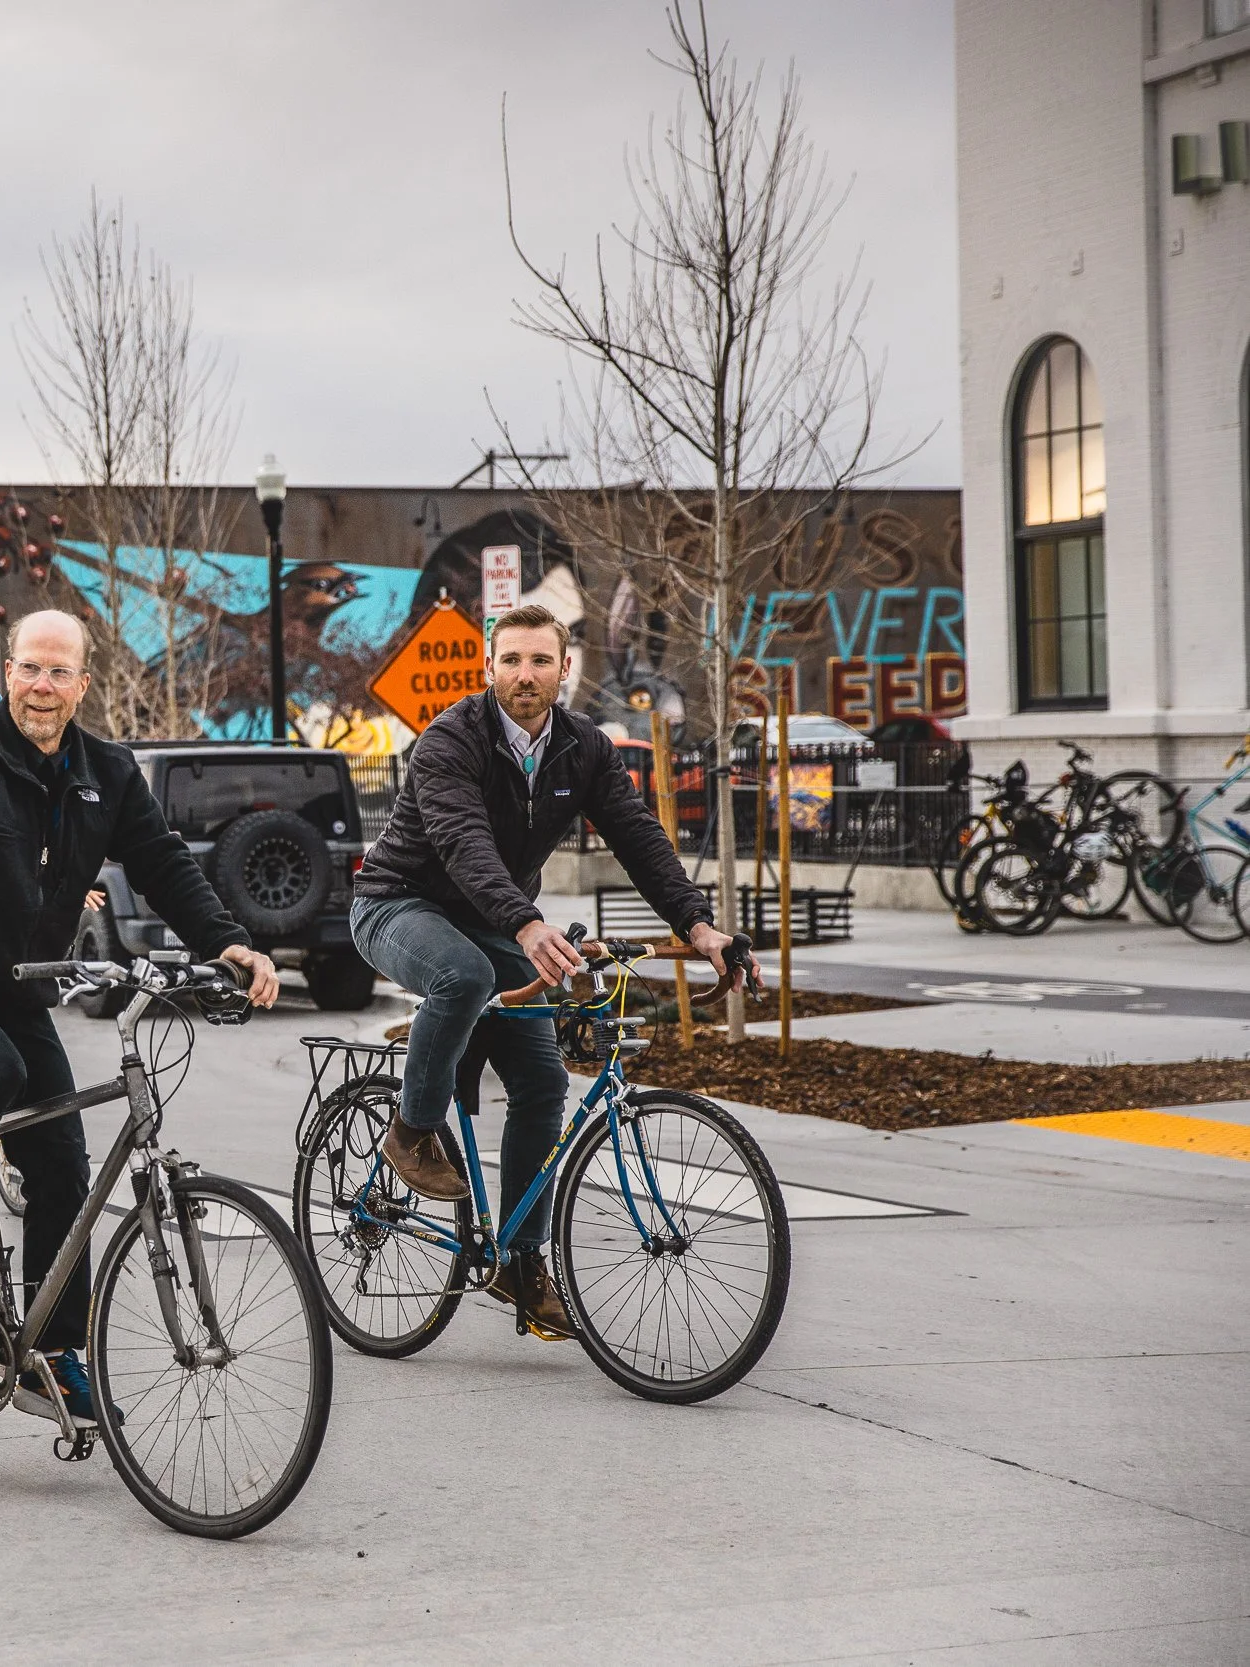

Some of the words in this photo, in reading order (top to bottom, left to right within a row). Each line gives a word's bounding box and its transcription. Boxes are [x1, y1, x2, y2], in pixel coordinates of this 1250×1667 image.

[494, 553, 509, 566] NO
[486, 569, 518, 580] PARKING
[704, 587, 964, 664] NEVER
[419, 639, 477, 662] ROAD
[411, 669, 486, 694] CLOSED
